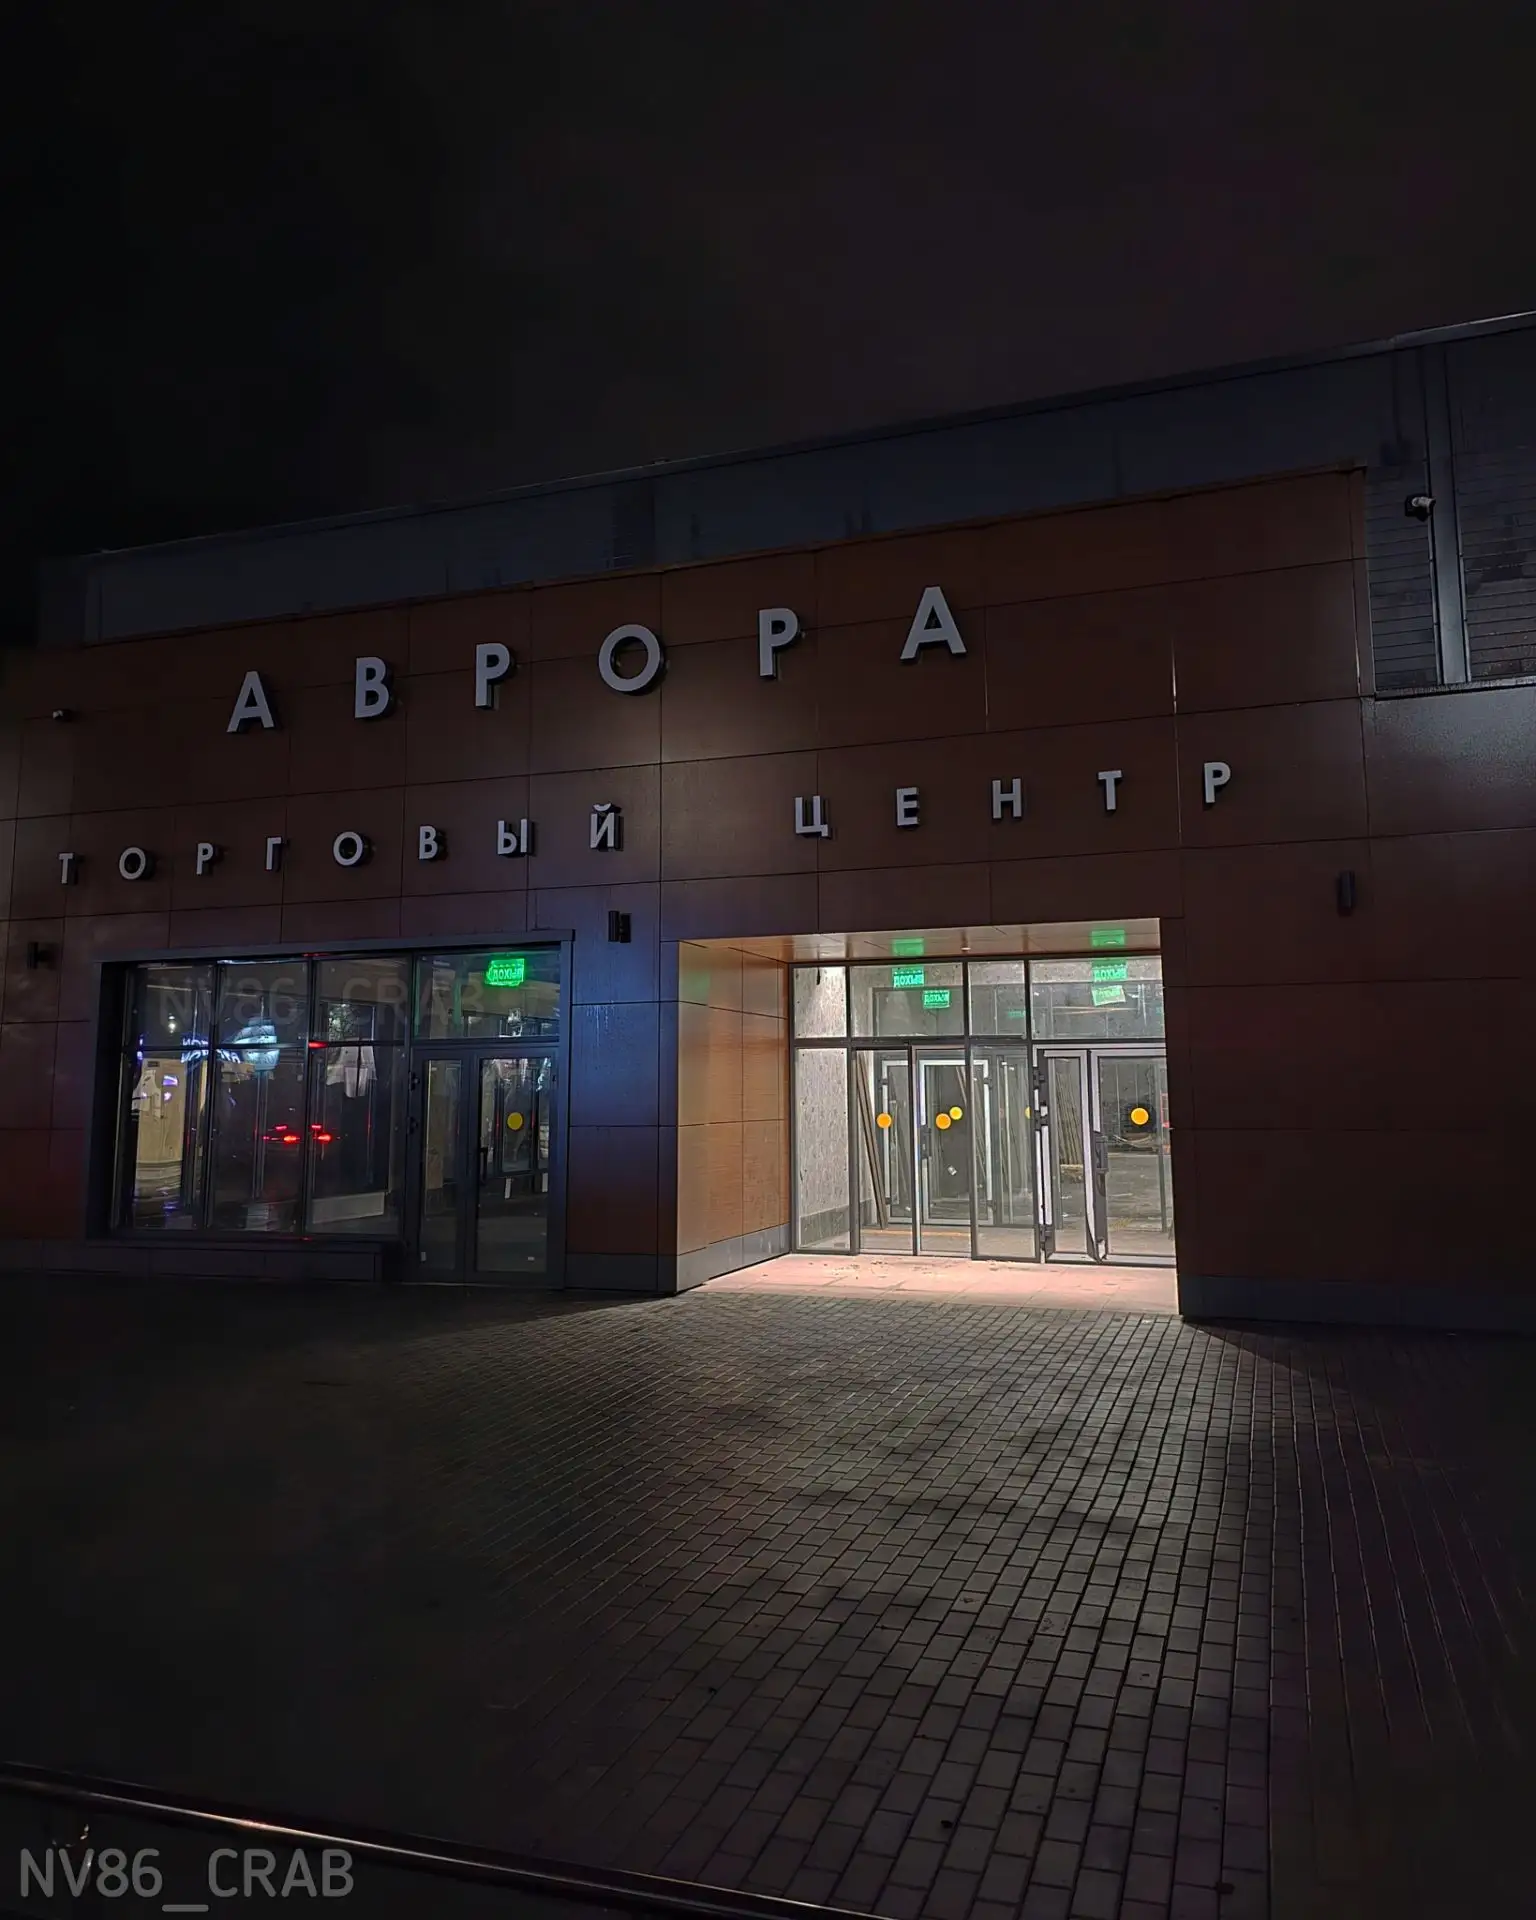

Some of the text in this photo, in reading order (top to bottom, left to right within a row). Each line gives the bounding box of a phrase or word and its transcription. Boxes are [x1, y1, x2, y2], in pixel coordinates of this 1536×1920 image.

[226, 585, 968, 733] АВРОРА
[58, 761, 1232, 885] ТОРГОВЫЙ ЦЕНТР
